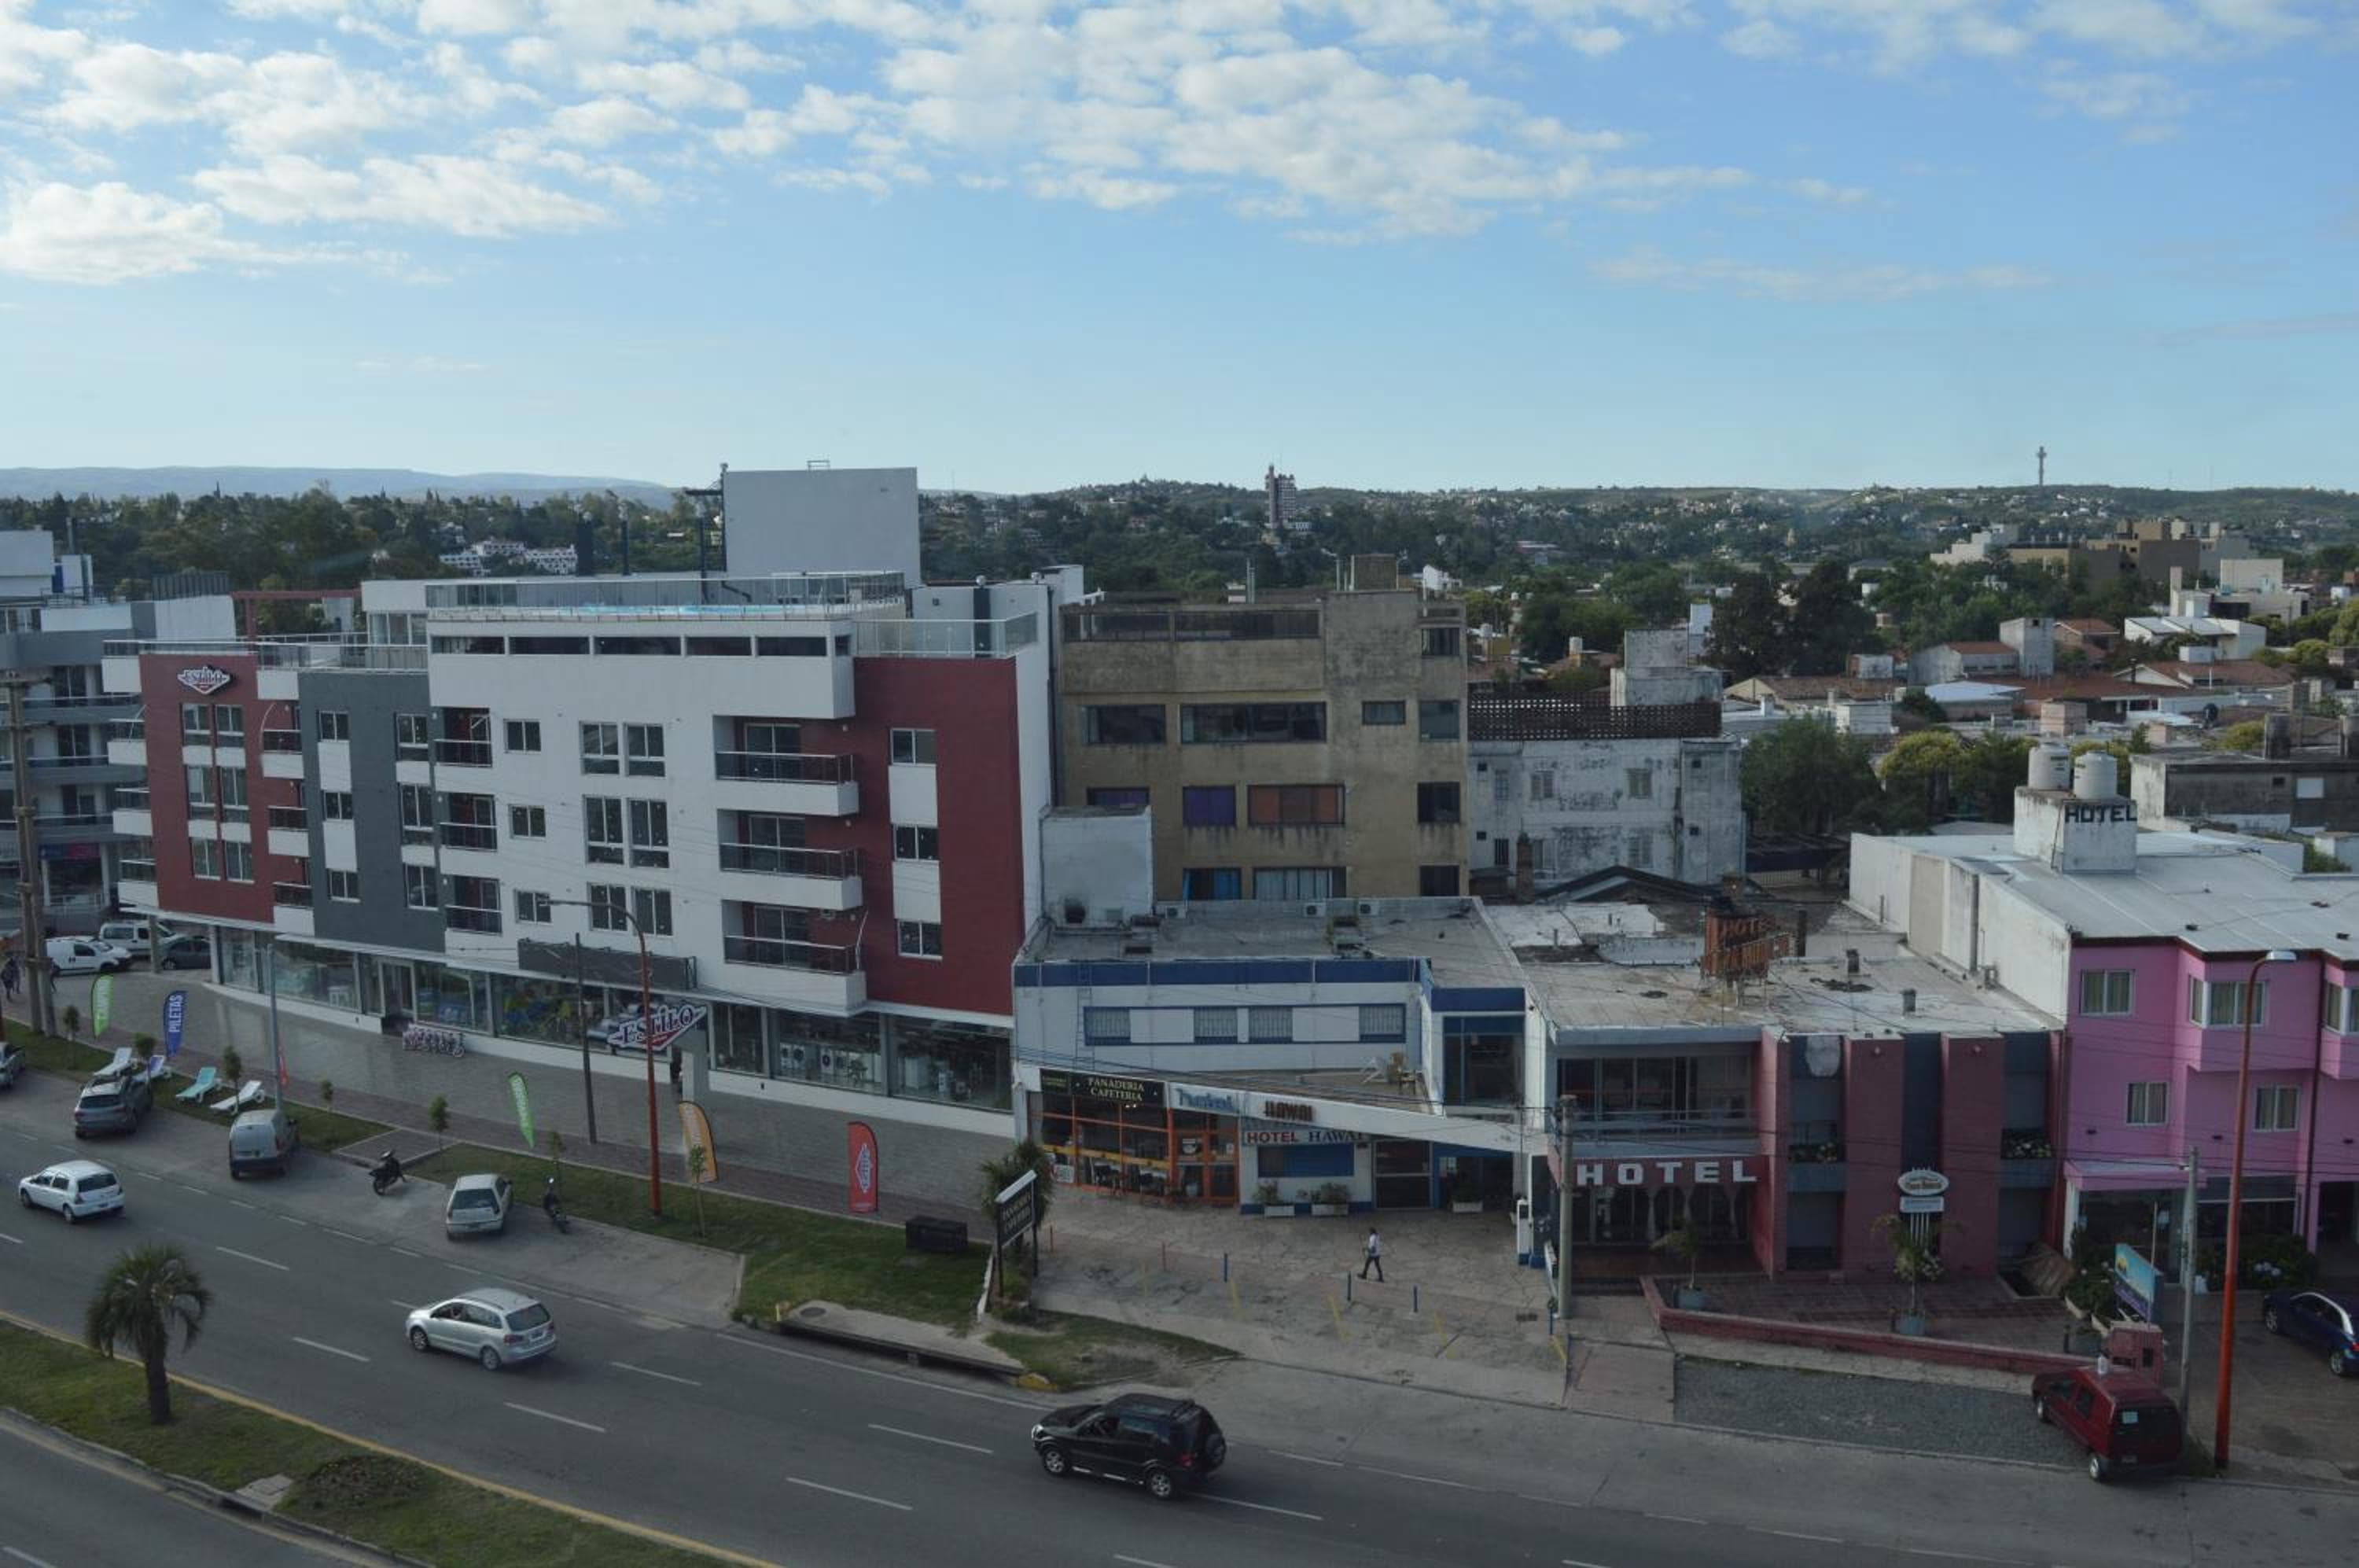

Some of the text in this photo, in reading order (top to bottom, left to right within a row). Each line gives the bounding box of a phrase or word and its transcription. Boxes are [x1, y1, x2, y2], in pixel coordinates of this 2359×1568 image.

[2065, 804, 2137, 823] HOTEL
[168, 995, 183, 1032] PILETAS
[1087, 1077, 1145, 1091] PANADERIA
[1090, 1088, 1143, 1101] CAFETERIA
[1247, 1132, 1297, 1144] HOTEL
[1576, 1160, 1758, 1186] HOTEL
